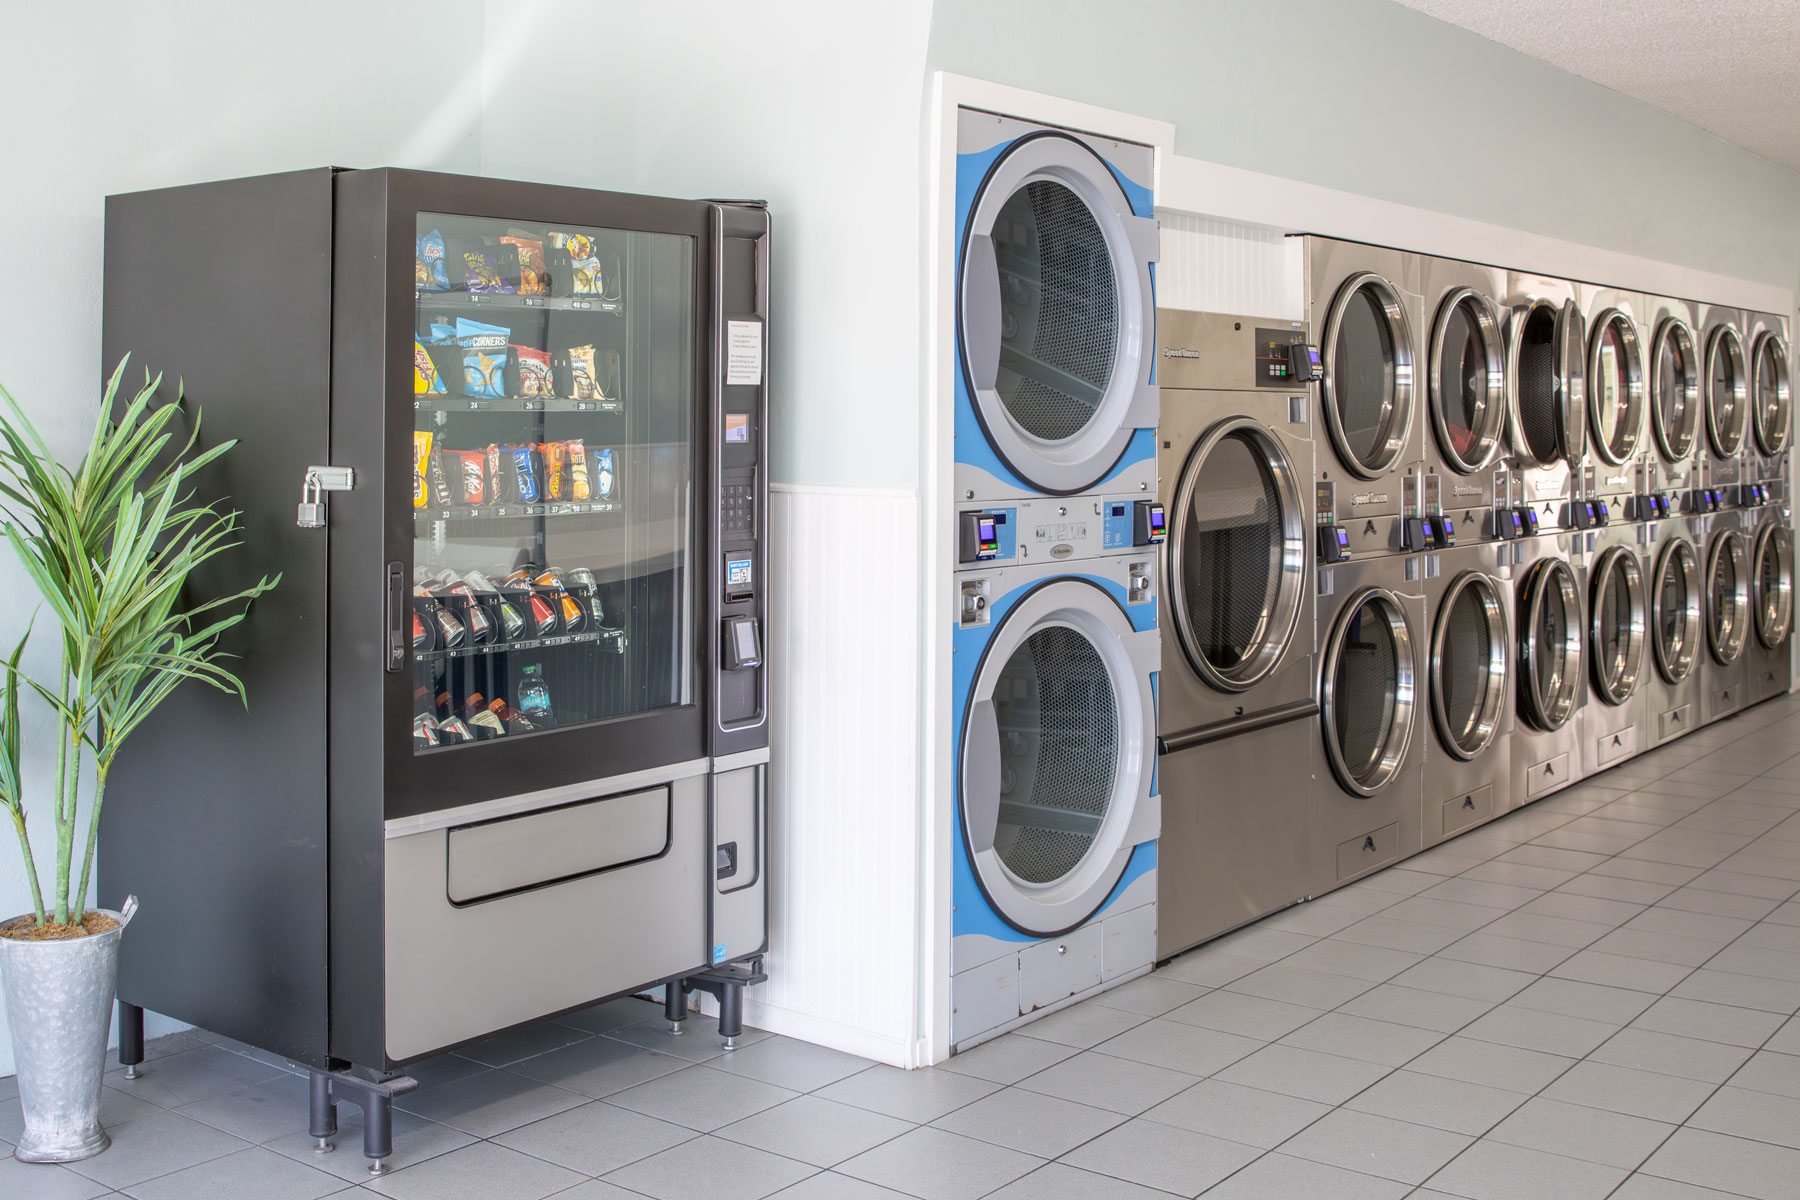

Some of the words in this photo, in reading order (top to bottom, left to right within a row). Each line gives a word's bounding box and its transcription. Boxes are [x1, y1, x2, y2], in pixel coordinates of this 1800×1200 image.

[470, 401, 478, 409] 24
[526, 402, 534, 410] 26
[471, 509, 479, 517] 34
[498, 508, 506, 516] 35
